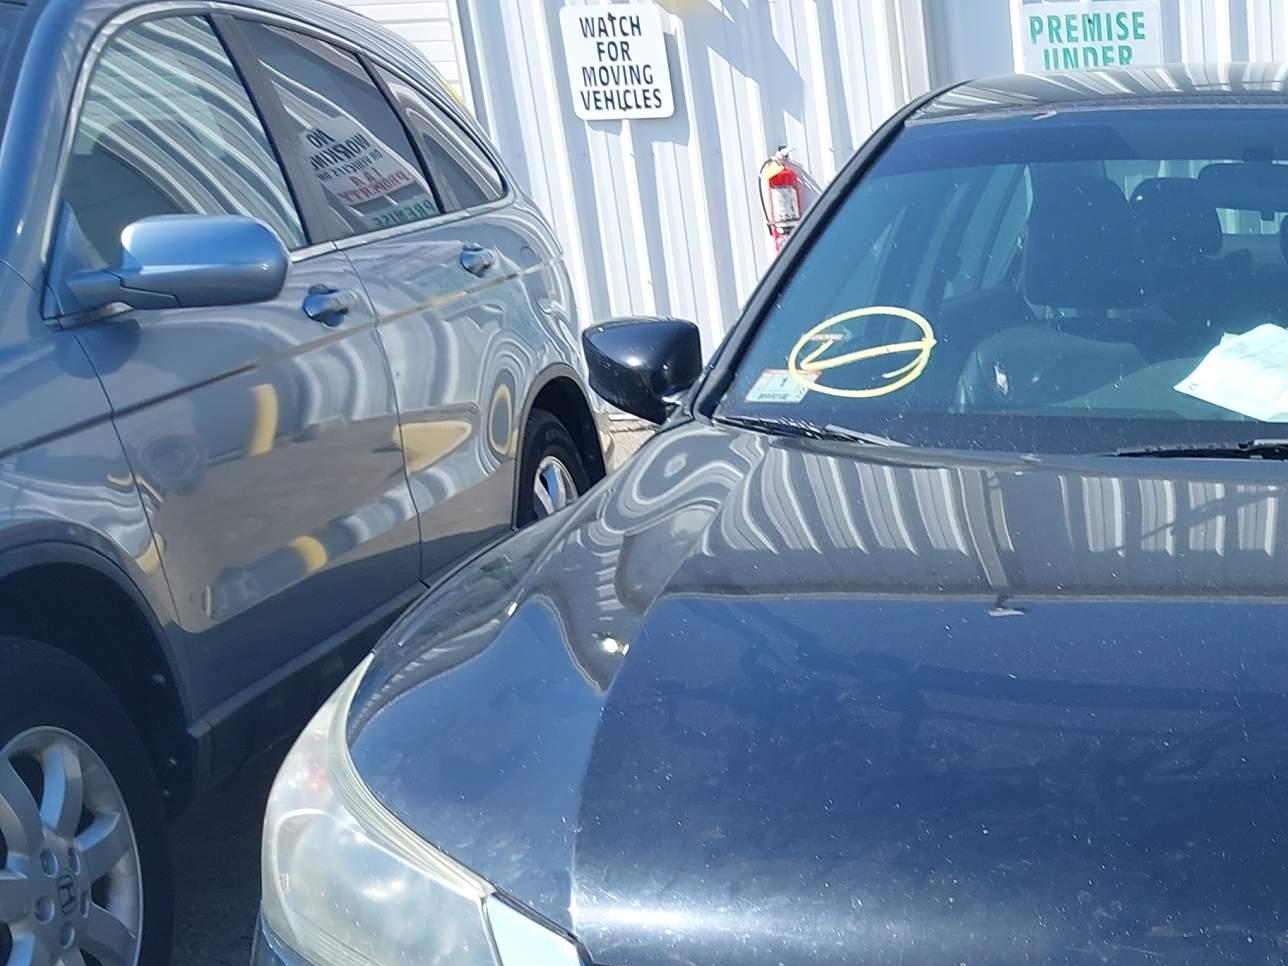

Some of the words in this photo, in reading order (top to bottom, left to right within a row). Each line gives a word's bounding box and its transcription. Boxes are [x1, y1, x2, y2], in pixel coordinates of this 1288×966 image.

[579, 14, 642, 38] WATCH
[1028, 11, 1146, 44] PREMISE
[596, 40, 632, 62] FOR
[582, 64, 654, 87] MOVING
[580, 88, 663, 111] VEHICLES
